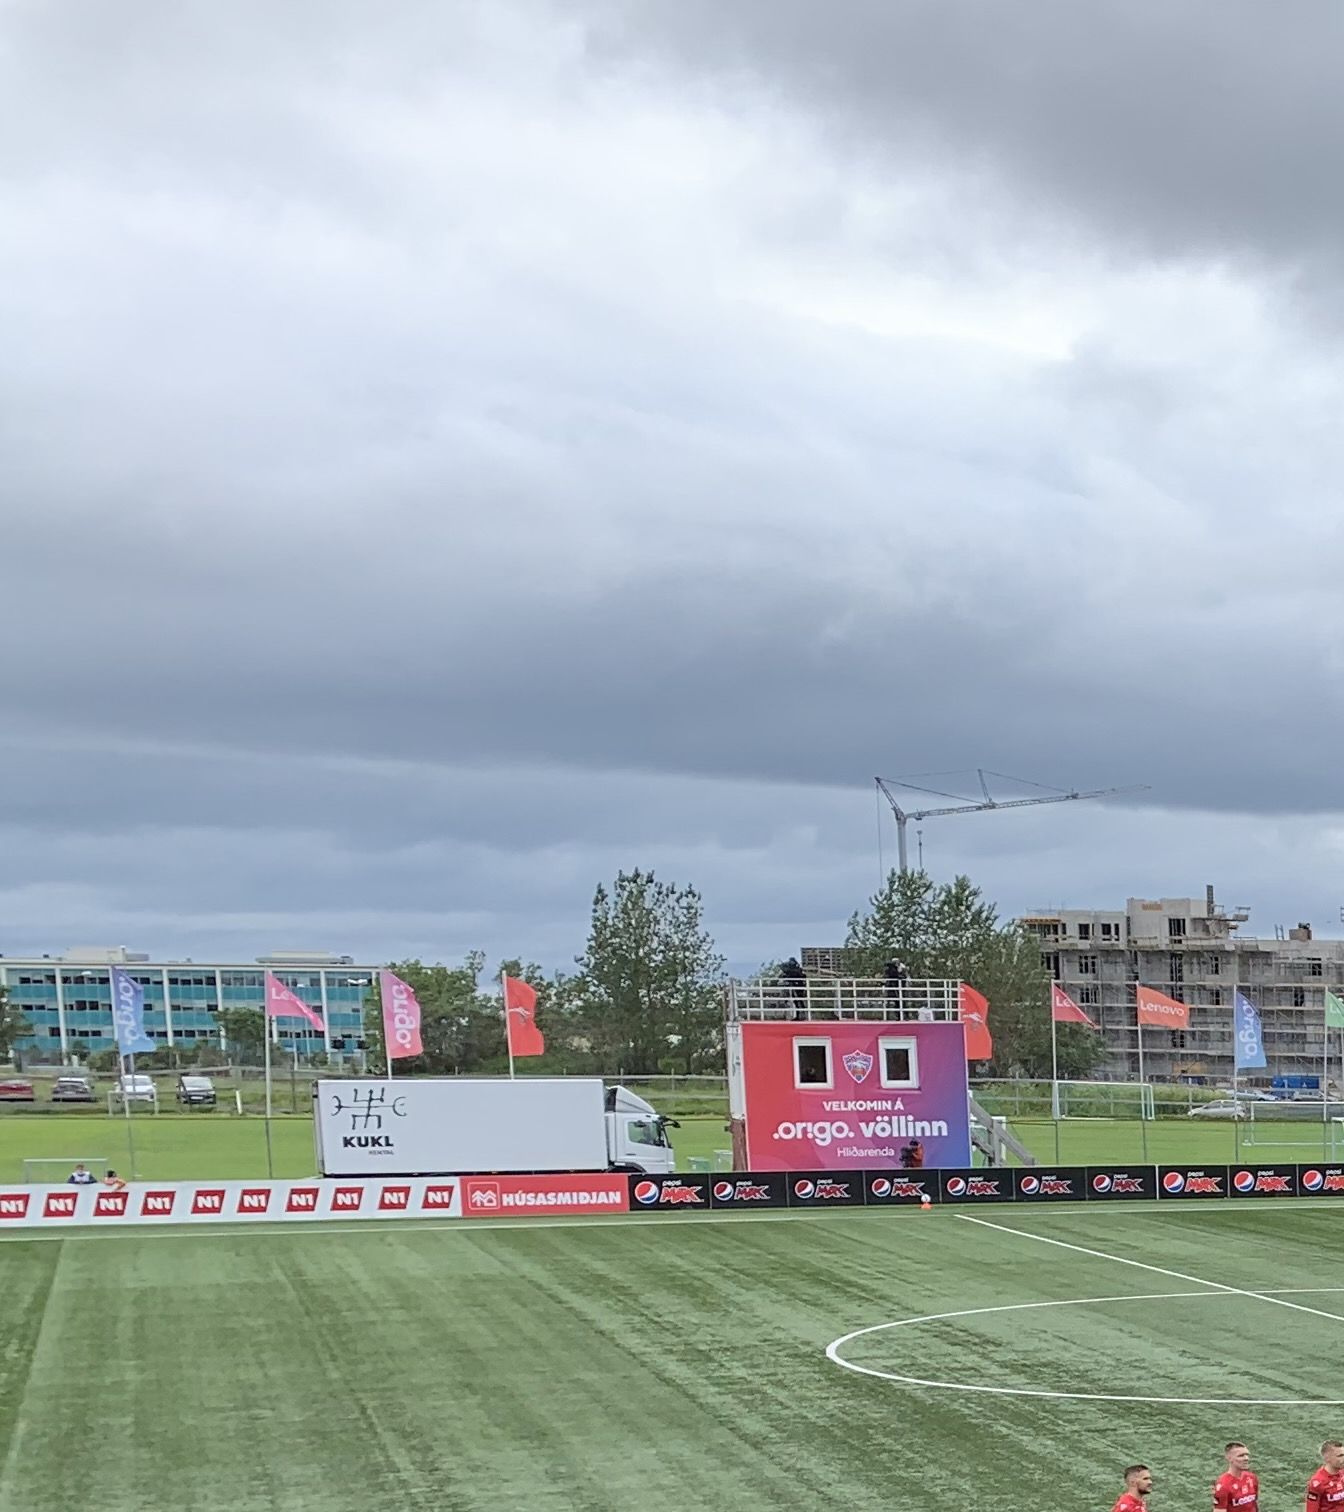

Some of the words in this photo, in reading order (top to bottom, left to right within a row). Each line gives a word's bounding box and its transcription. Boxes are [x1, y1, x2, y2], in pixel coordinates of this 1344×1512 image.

[1140, 999, 1185, 1017] Lenovo
[822, 1100, 892, 1112] VELKOMIN
[893, 1097, 905, 1111] Á
[859, 1115, 949, 1138] völlinn
[342, 1135, 394, 1148] KUKL
[146, 1196, 171, 1211] N1
[195, 1195, 221, 1209] N1
[242, 1194, 267, 1208] N1
[291, 1192, 314, 1207] N1
[336, 1192, 359, 1206] N1
[383, 1191, 407, 1205] N1
[426, 1190, 450, 1204] N1
[48, 1198, 73, 1212] N1
[98, 1197, 124, 1212] N1
